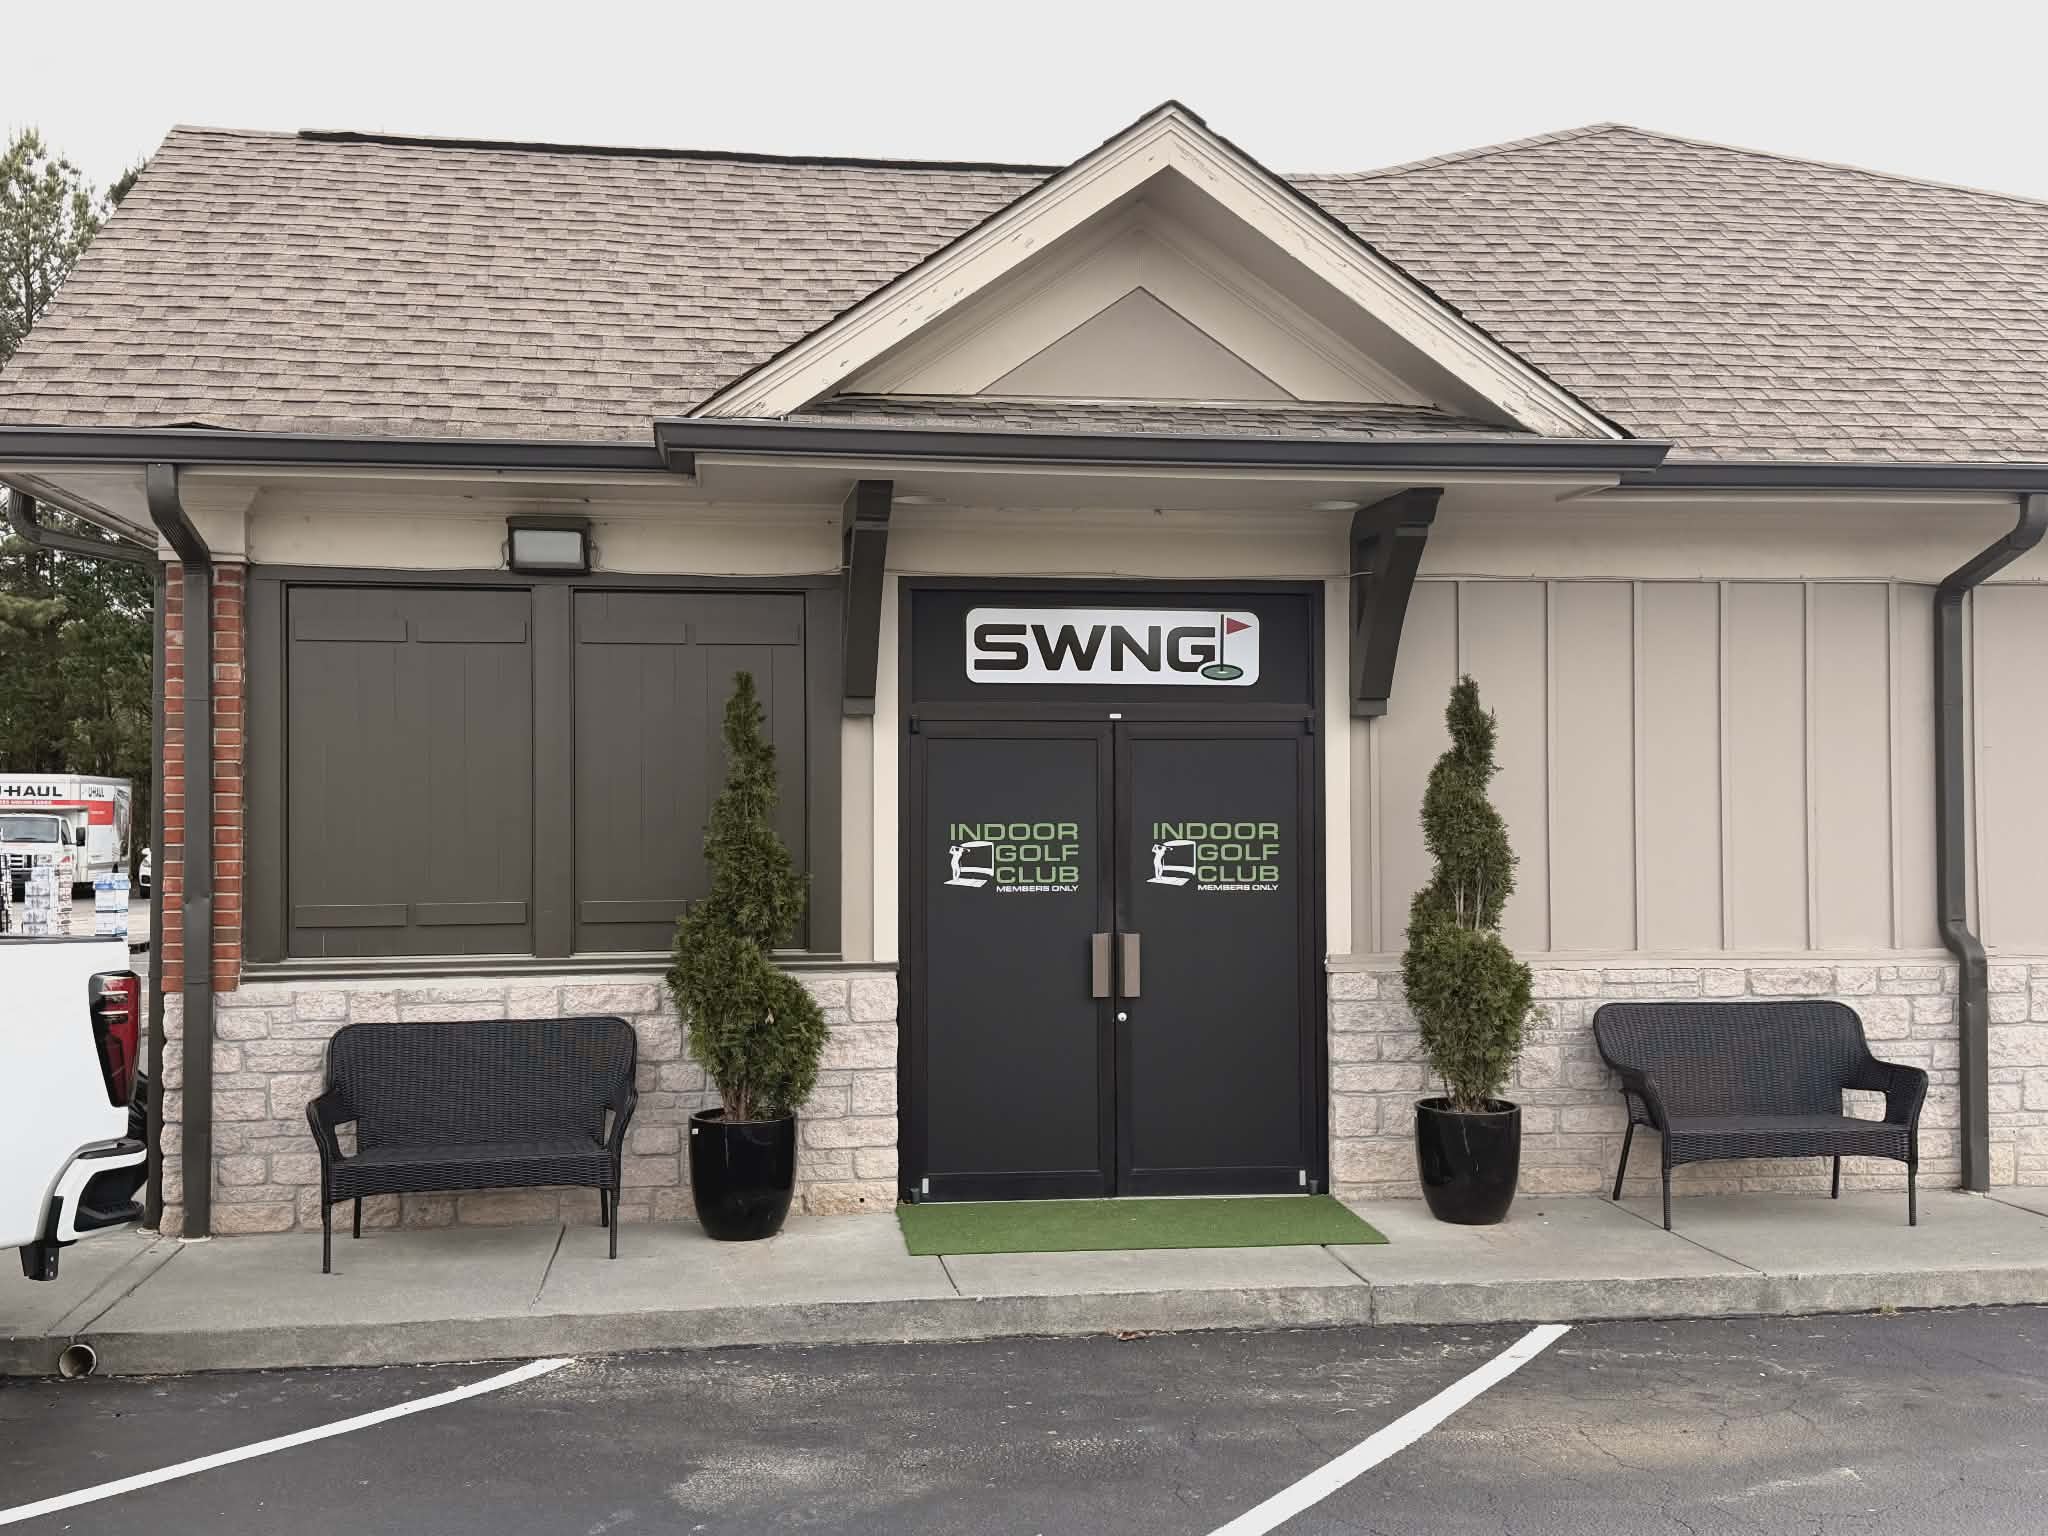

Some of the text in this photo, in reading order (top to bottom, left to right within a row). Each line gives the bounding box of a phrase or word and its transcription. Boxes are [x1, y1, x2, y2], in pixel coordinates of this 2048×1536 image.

[974, 623, 1215, 673] SWNG
[0, 785, 63, 797] -HAUL
[950, 823, 1078, 841] INDOOR
[1153, 822, 1279, 840] INDOOR
[995, 844, 1079, 862] GOLF
[1197, 843, 1280, 861] GOLF
[996, 866, 1079, 884] CLUB
[1198, 865, 1279, 882] CLUB
